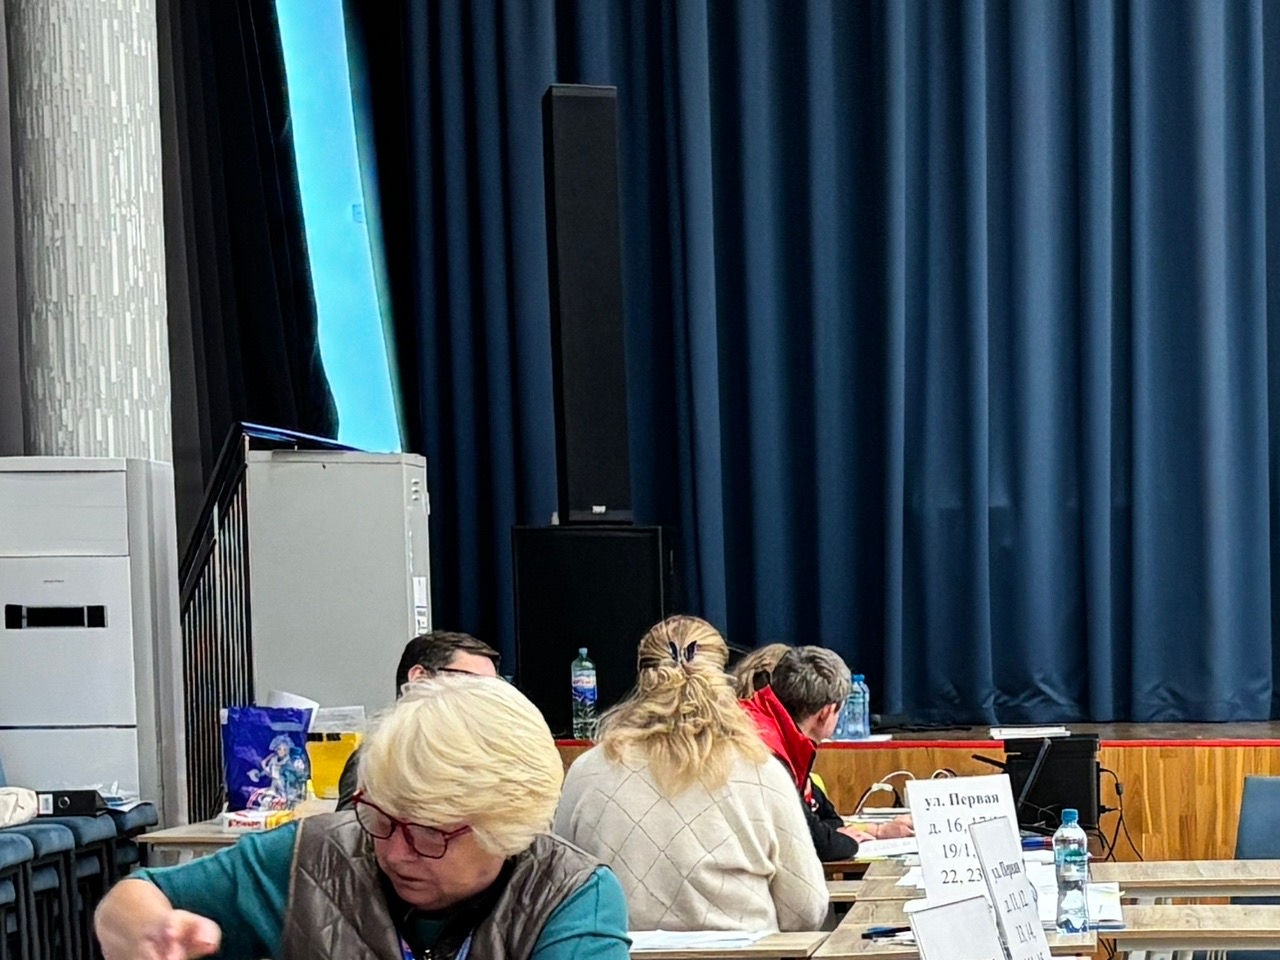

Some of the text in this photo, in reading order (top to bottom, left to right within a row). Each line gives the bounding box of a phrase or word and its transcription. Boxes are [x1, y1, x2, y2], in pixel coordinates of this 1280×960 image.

[925, 793, 999, 811] ул. Первая
[928, 823, 941, 835] д.
[947, 817, 967, 834] 16,
[943, 843, 976, 859] 19/1,
[941, 869, 963, 885] 22,
